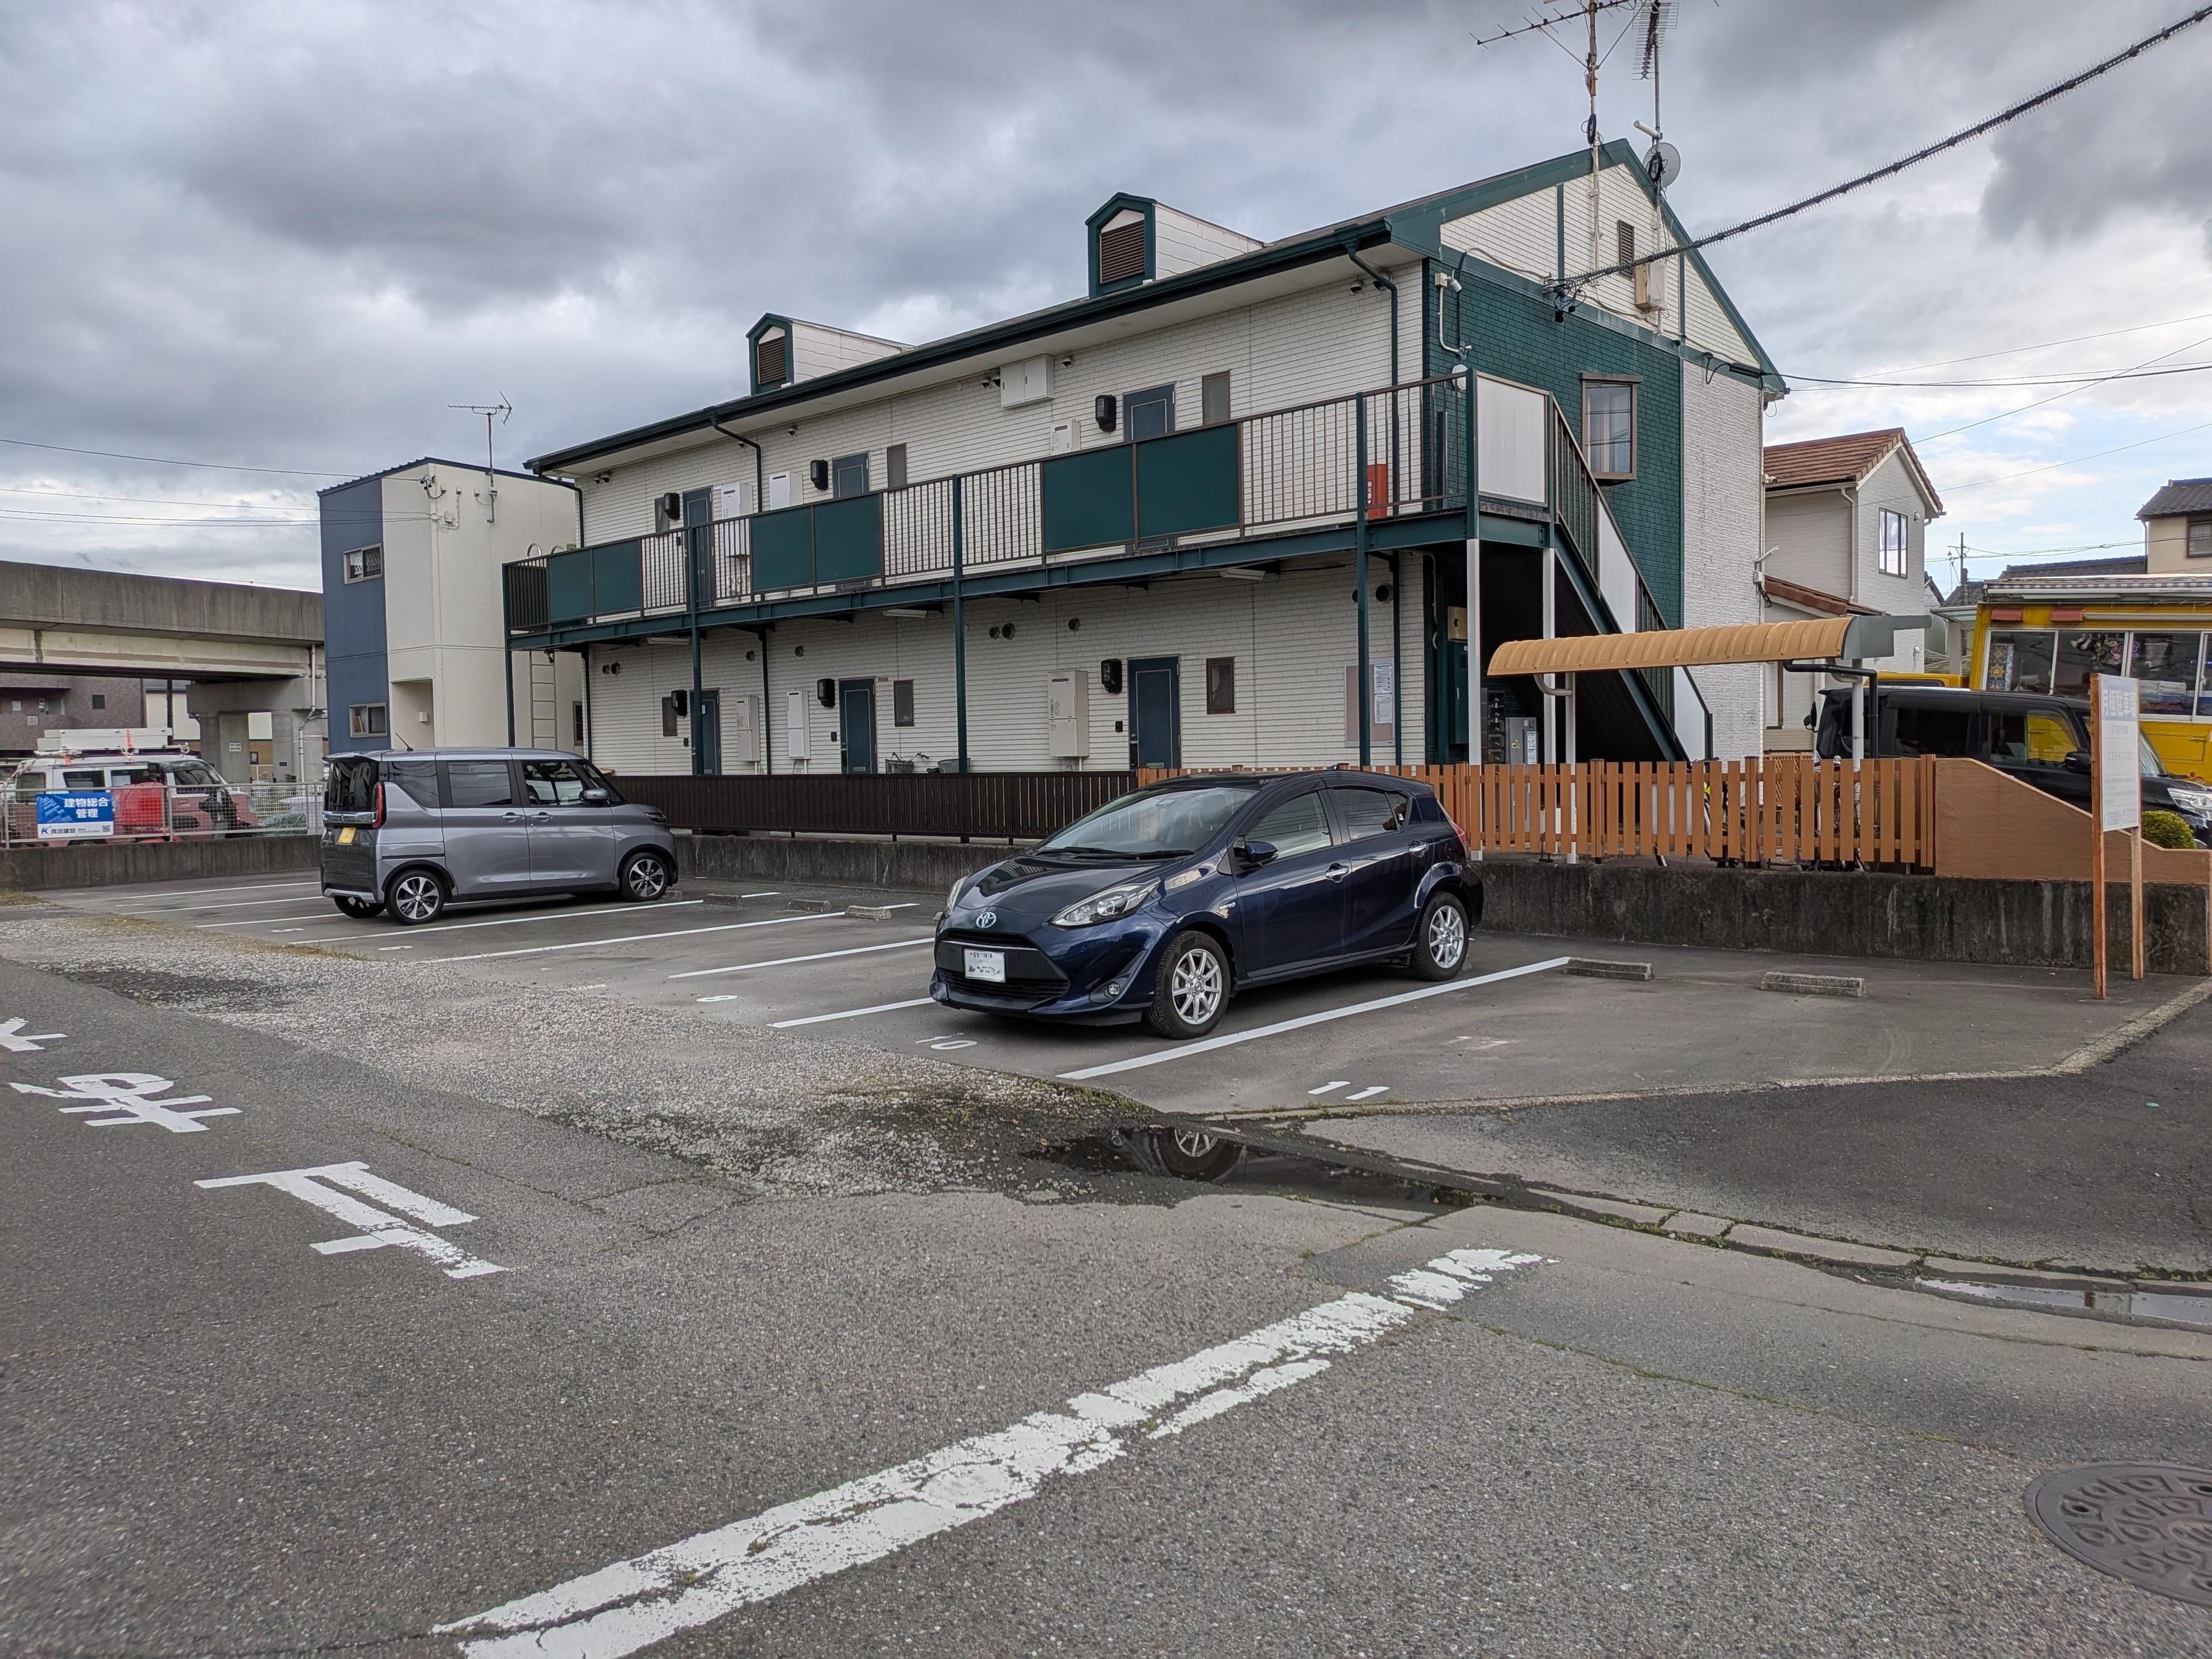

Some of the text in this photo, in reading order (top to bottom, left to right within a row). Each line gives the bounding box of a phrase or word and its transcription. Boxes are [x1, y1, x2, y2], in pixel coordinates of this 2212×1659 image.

[64, 797, 109, 808] 建物総合
[76, 808, 99, 819] 管理
[1307, 1081, 1391, 1100] 11
